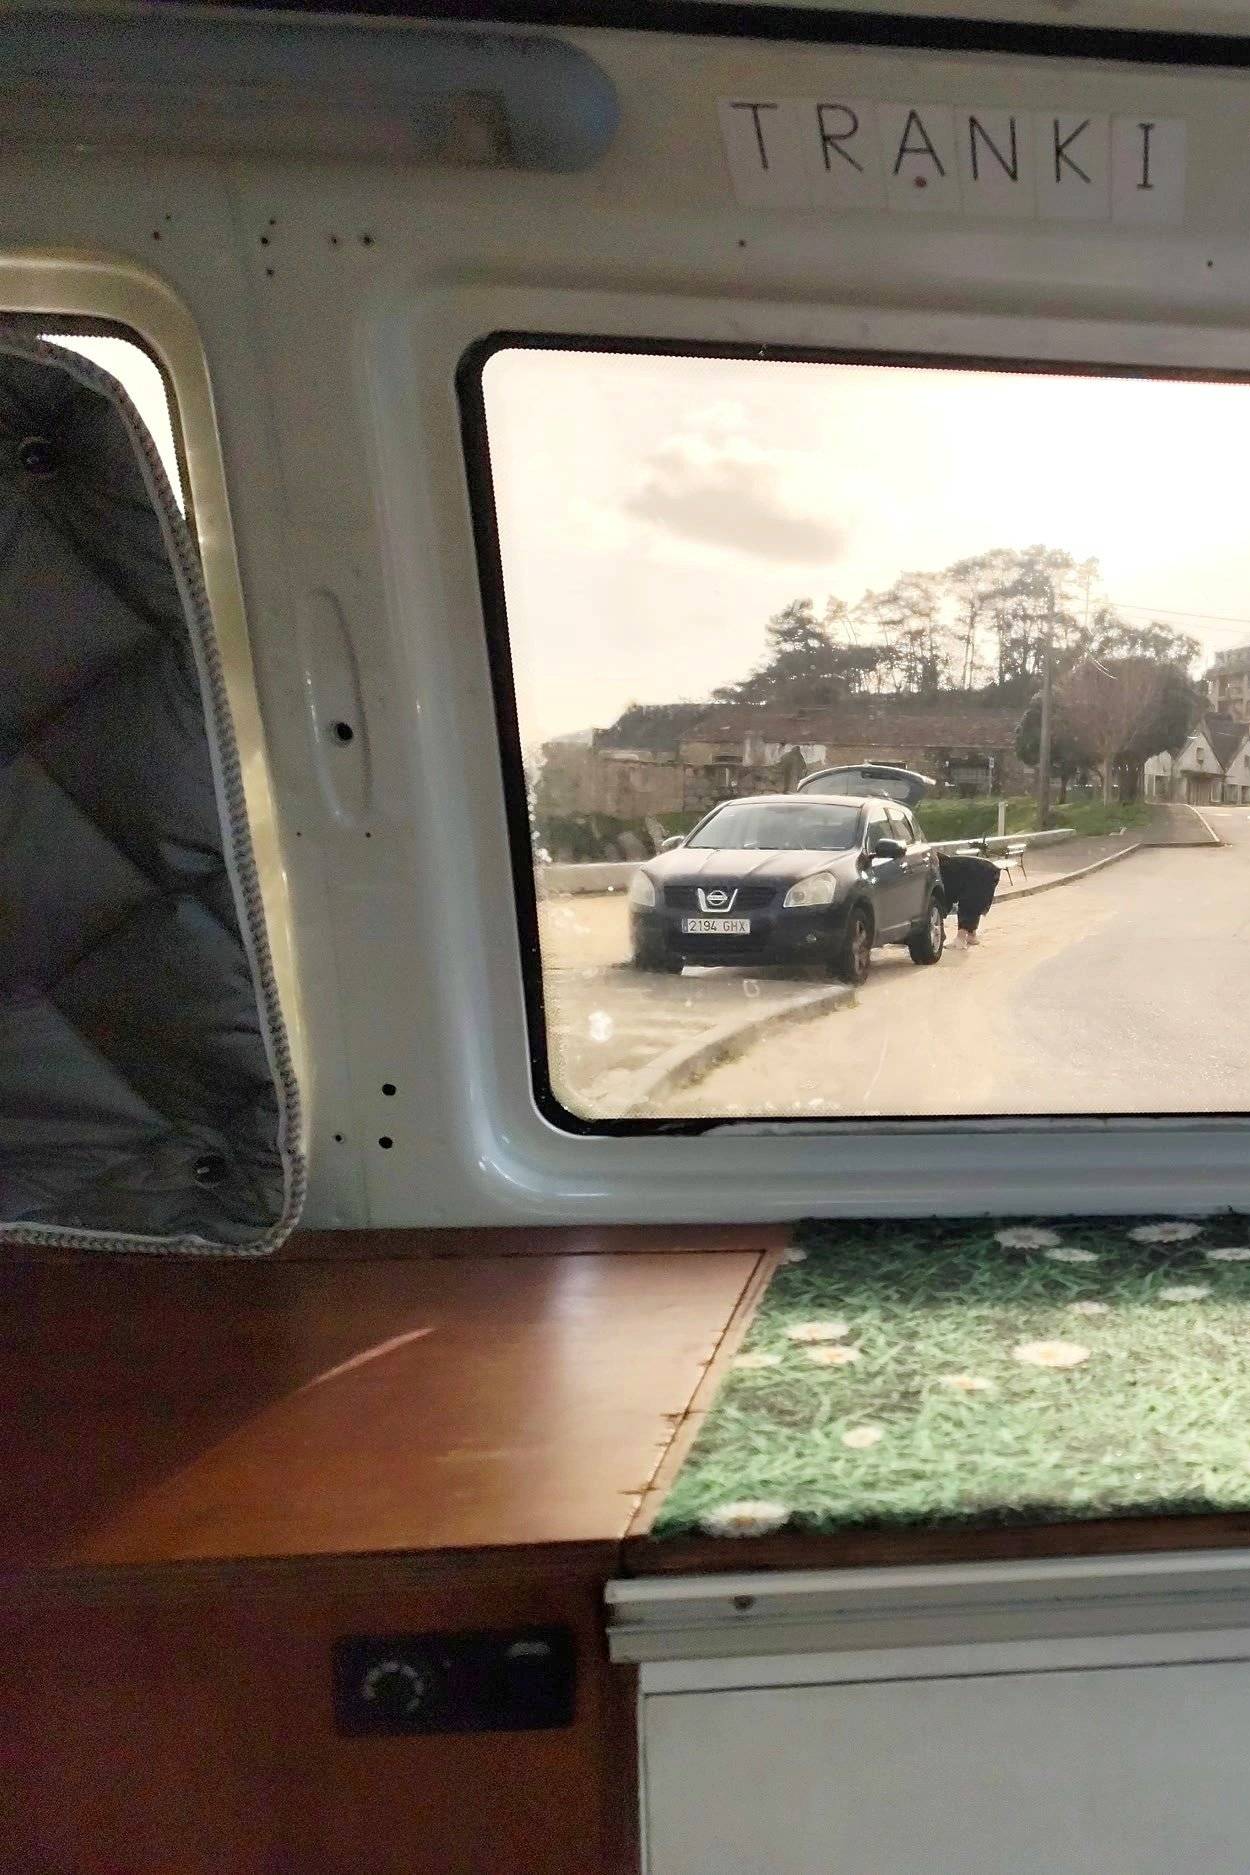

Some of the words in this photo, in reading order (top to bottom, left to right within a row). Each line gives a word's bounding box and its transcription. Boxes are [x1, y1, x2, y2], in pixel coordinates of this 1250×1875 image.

[730, 102, 1154, 190] TRANKI
[688, 920, 717, 932] 2194
[723, 920, 746, 932] GHX
